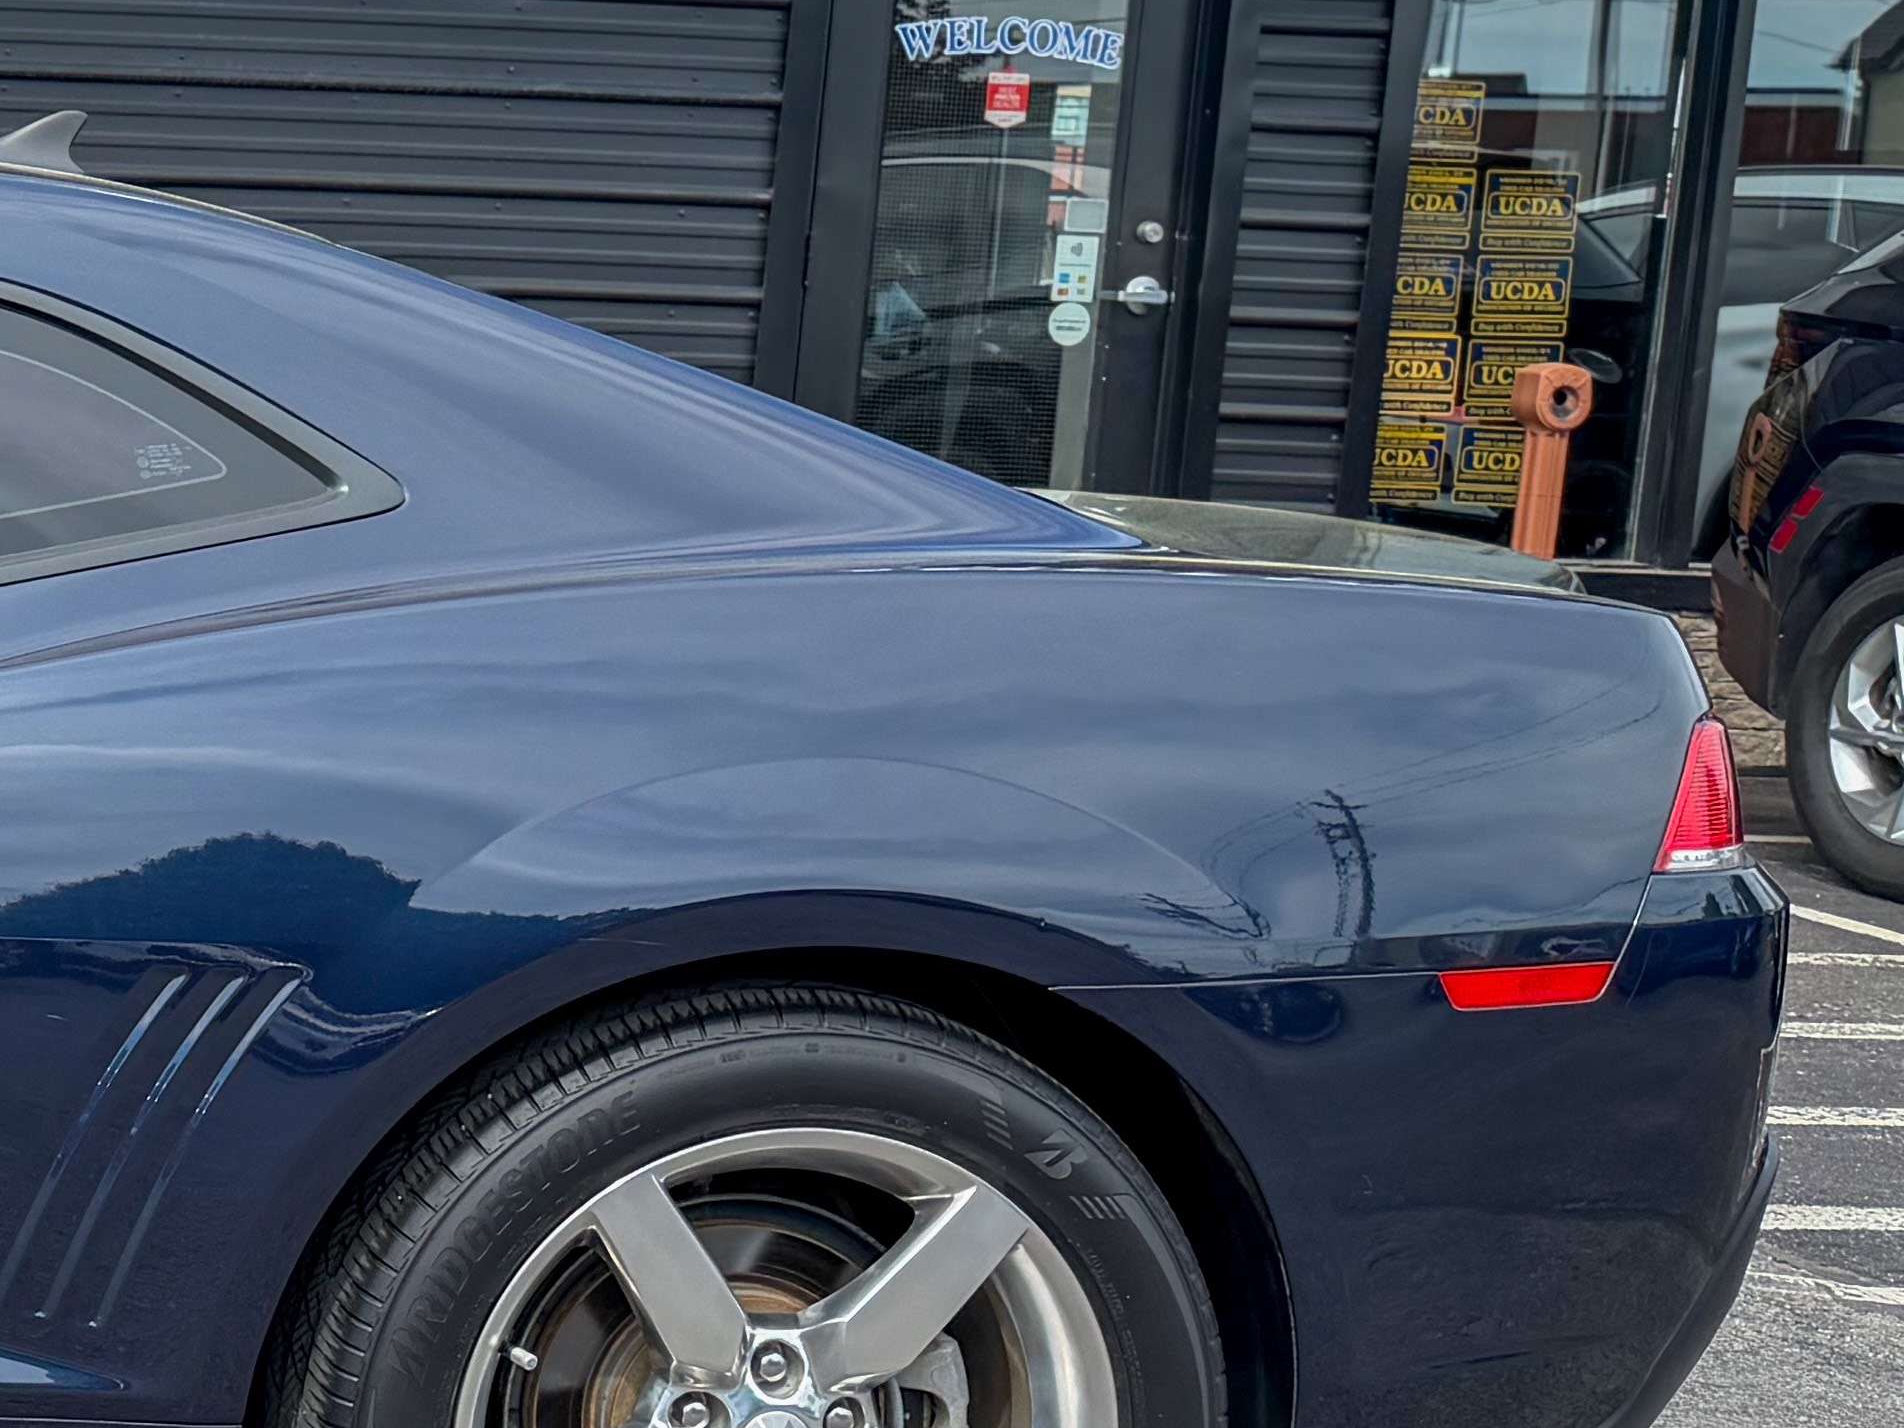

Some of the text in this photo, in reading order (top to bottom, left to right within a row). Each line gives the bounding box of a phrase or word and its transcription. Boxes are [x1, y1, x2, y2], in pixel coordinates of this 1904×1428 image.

[895, 16, 1125, 70] WELCOME
[1418, 105, 1467, 126] CDA
[1498, 196, 1565, 216] UCDA
[1396, 275, 1447, 296] CDA
[1490, 281, 1556, 301] UCDA
[1482, 365, 1514, 385] UC
[1473, 451, 1520, 471] UCD
